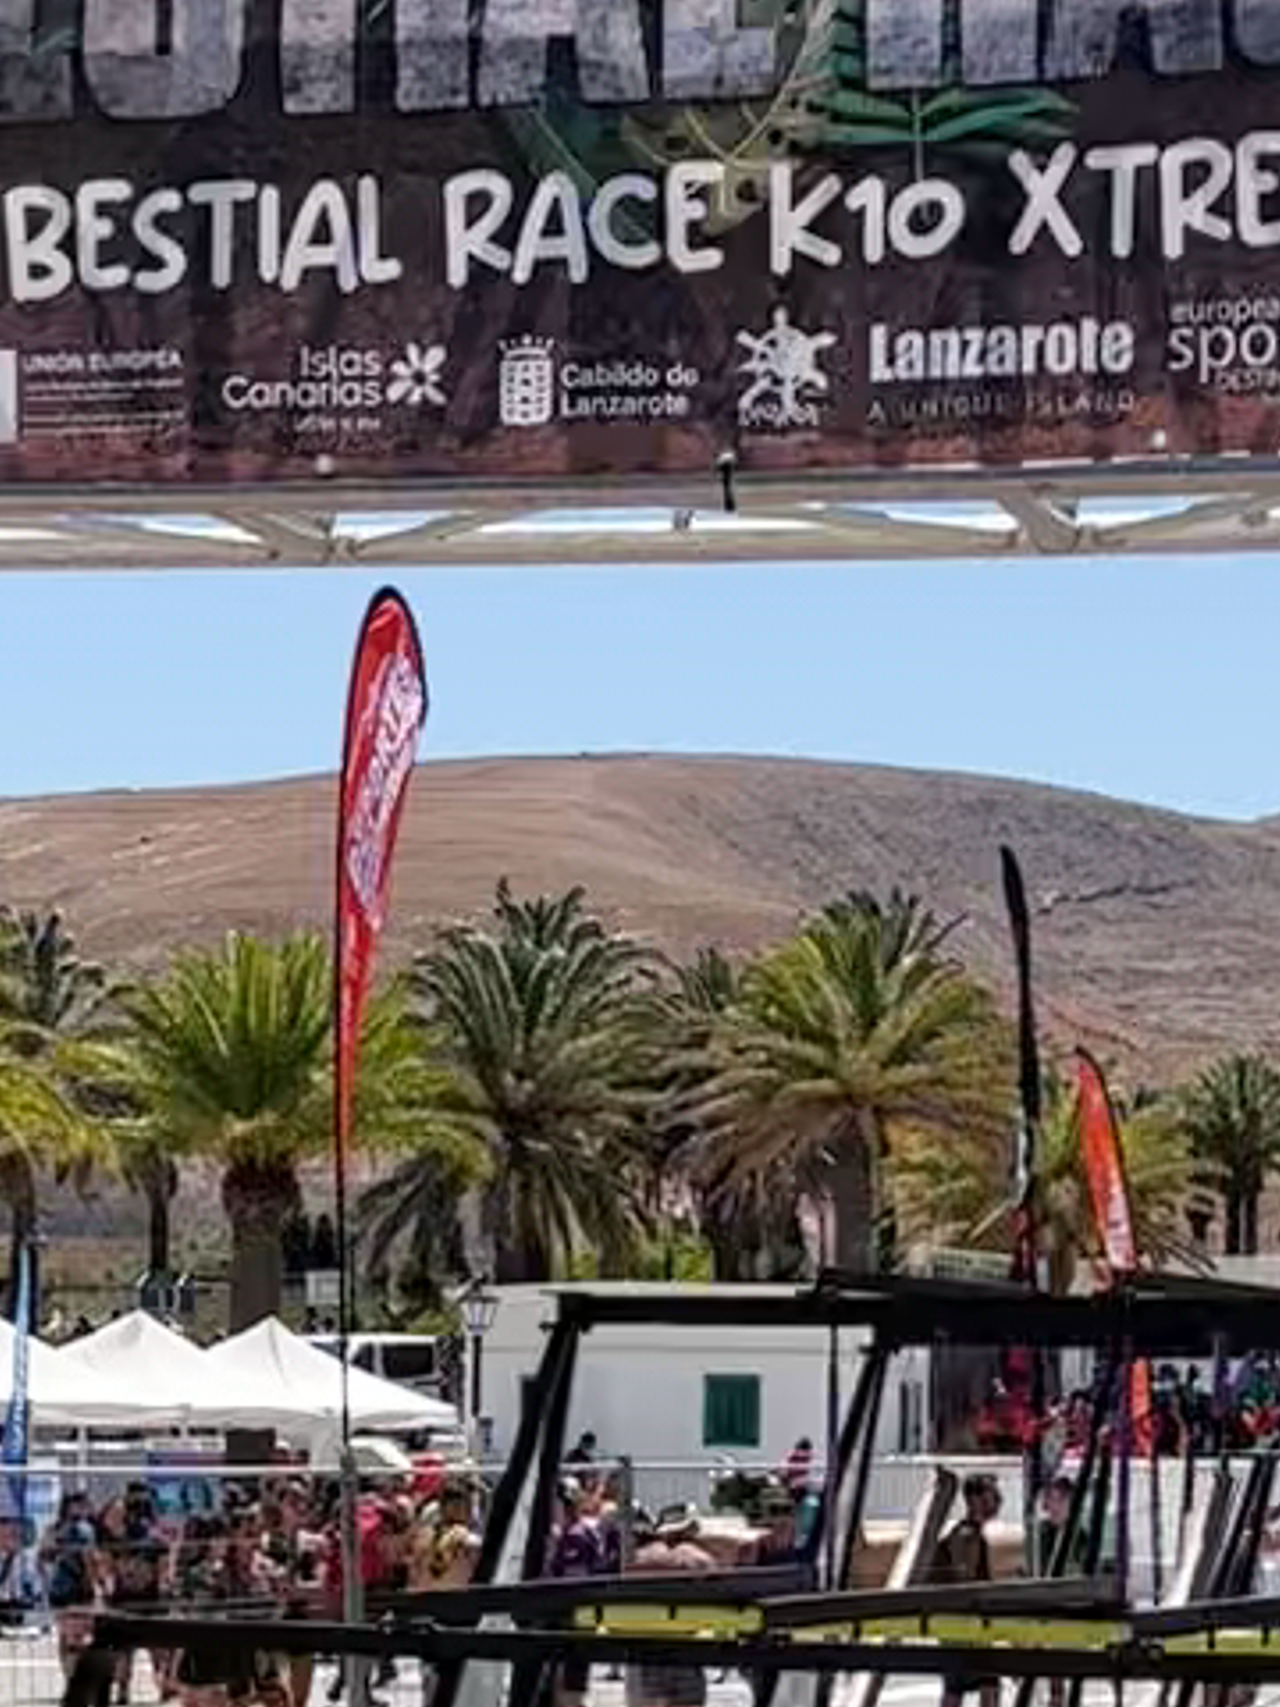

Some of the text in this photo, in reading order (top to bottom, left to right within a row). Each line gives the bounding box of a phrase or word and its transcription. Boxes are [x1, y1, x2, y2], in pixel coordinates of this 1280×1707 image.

[4, 177, 400, 301] BESTIAL
[445, 161, 726, 288] RACE
[768, 169, 966, 273] K10
[299, 345, 383, 378] Islas
[869, 317, 1135, 384] Lanzarote
[221, 373, 383, 409] Canarias
[560, 363, 700, 388] Cabildo de
[560, 392, 690, 418] Lanzarote
